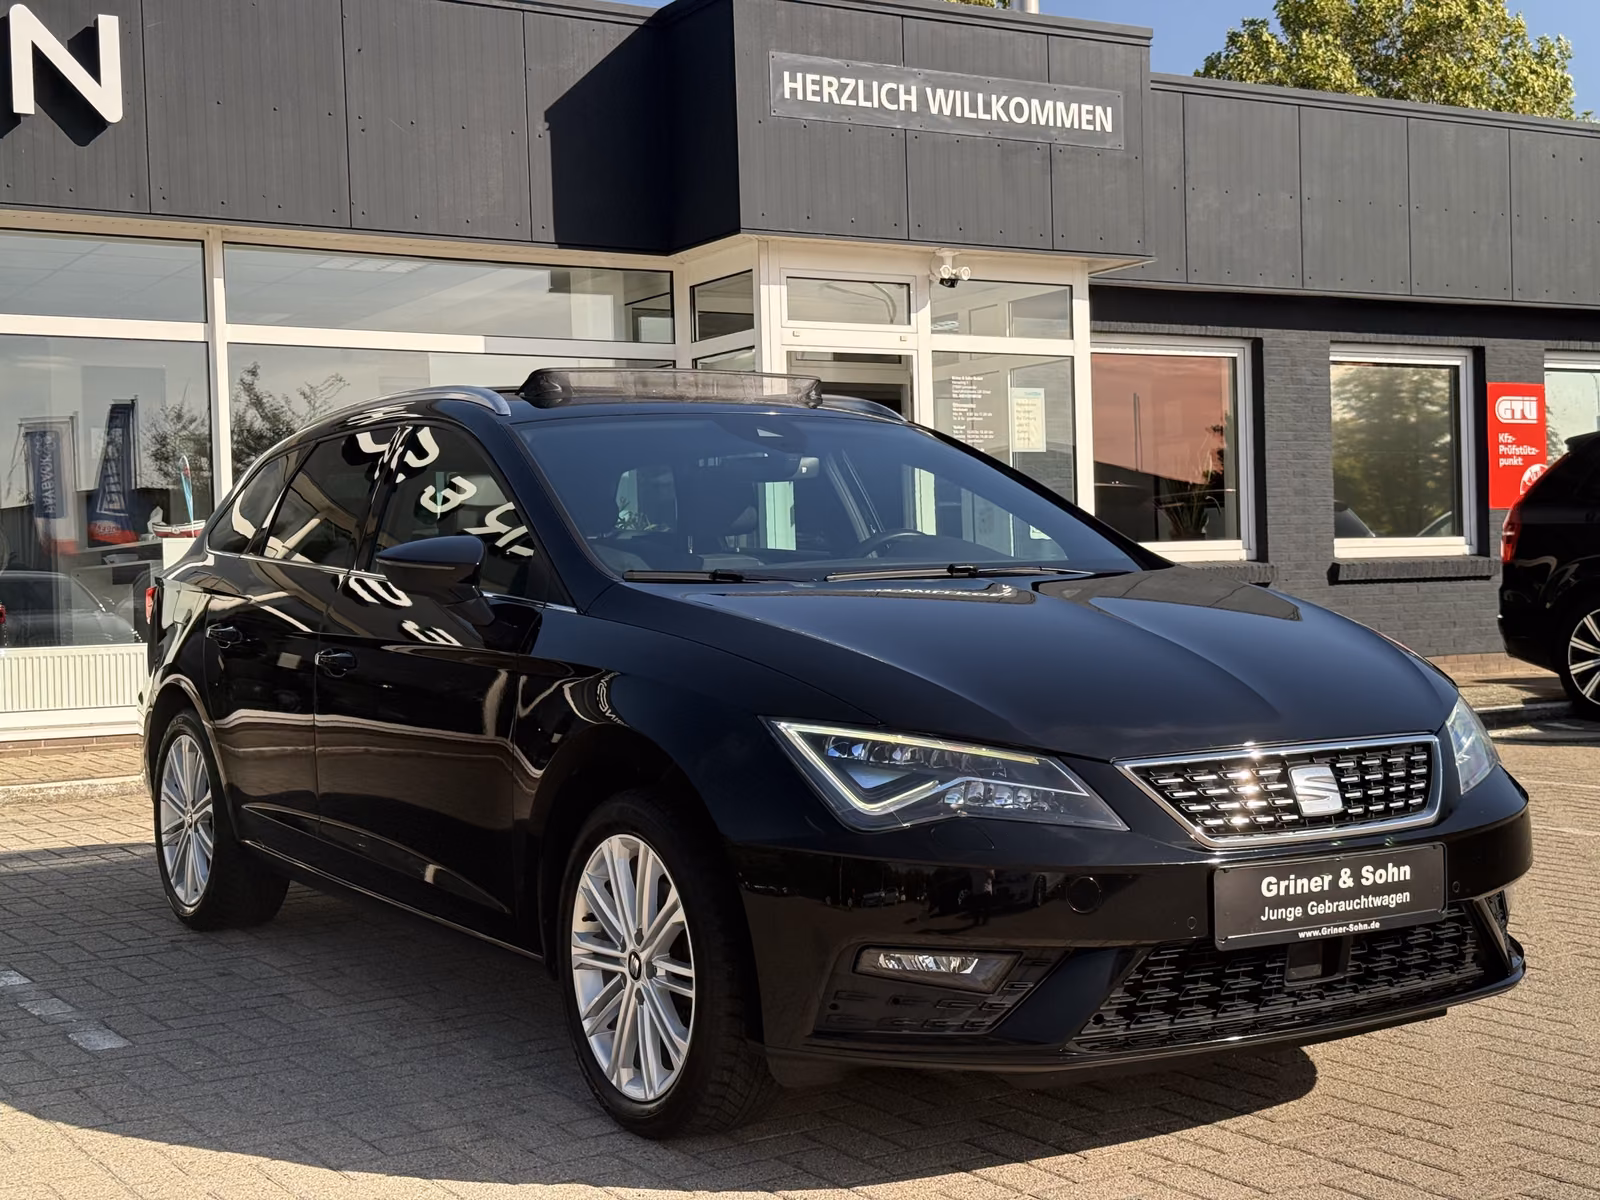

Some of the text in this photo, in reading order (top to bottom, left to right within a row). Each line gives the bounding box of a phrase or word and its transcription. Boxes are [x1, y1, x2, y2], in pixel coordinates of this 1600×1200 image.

[782, 70, 1113, 133] HERZLICH WILLKOMMEN
[1498, 433, 1516, 443] Kfz-
[1498, 444, 1540, 456] Prüfstütz-
[1499, 456, 1524, 468] punkt
[1261, 862, 1411, 897] Griner & Sohn
[1260, 891, 1411, 922] Junge Gebrauchtwagen
[1298, 921, 1381, 939] www.Griner-Sohn.de
